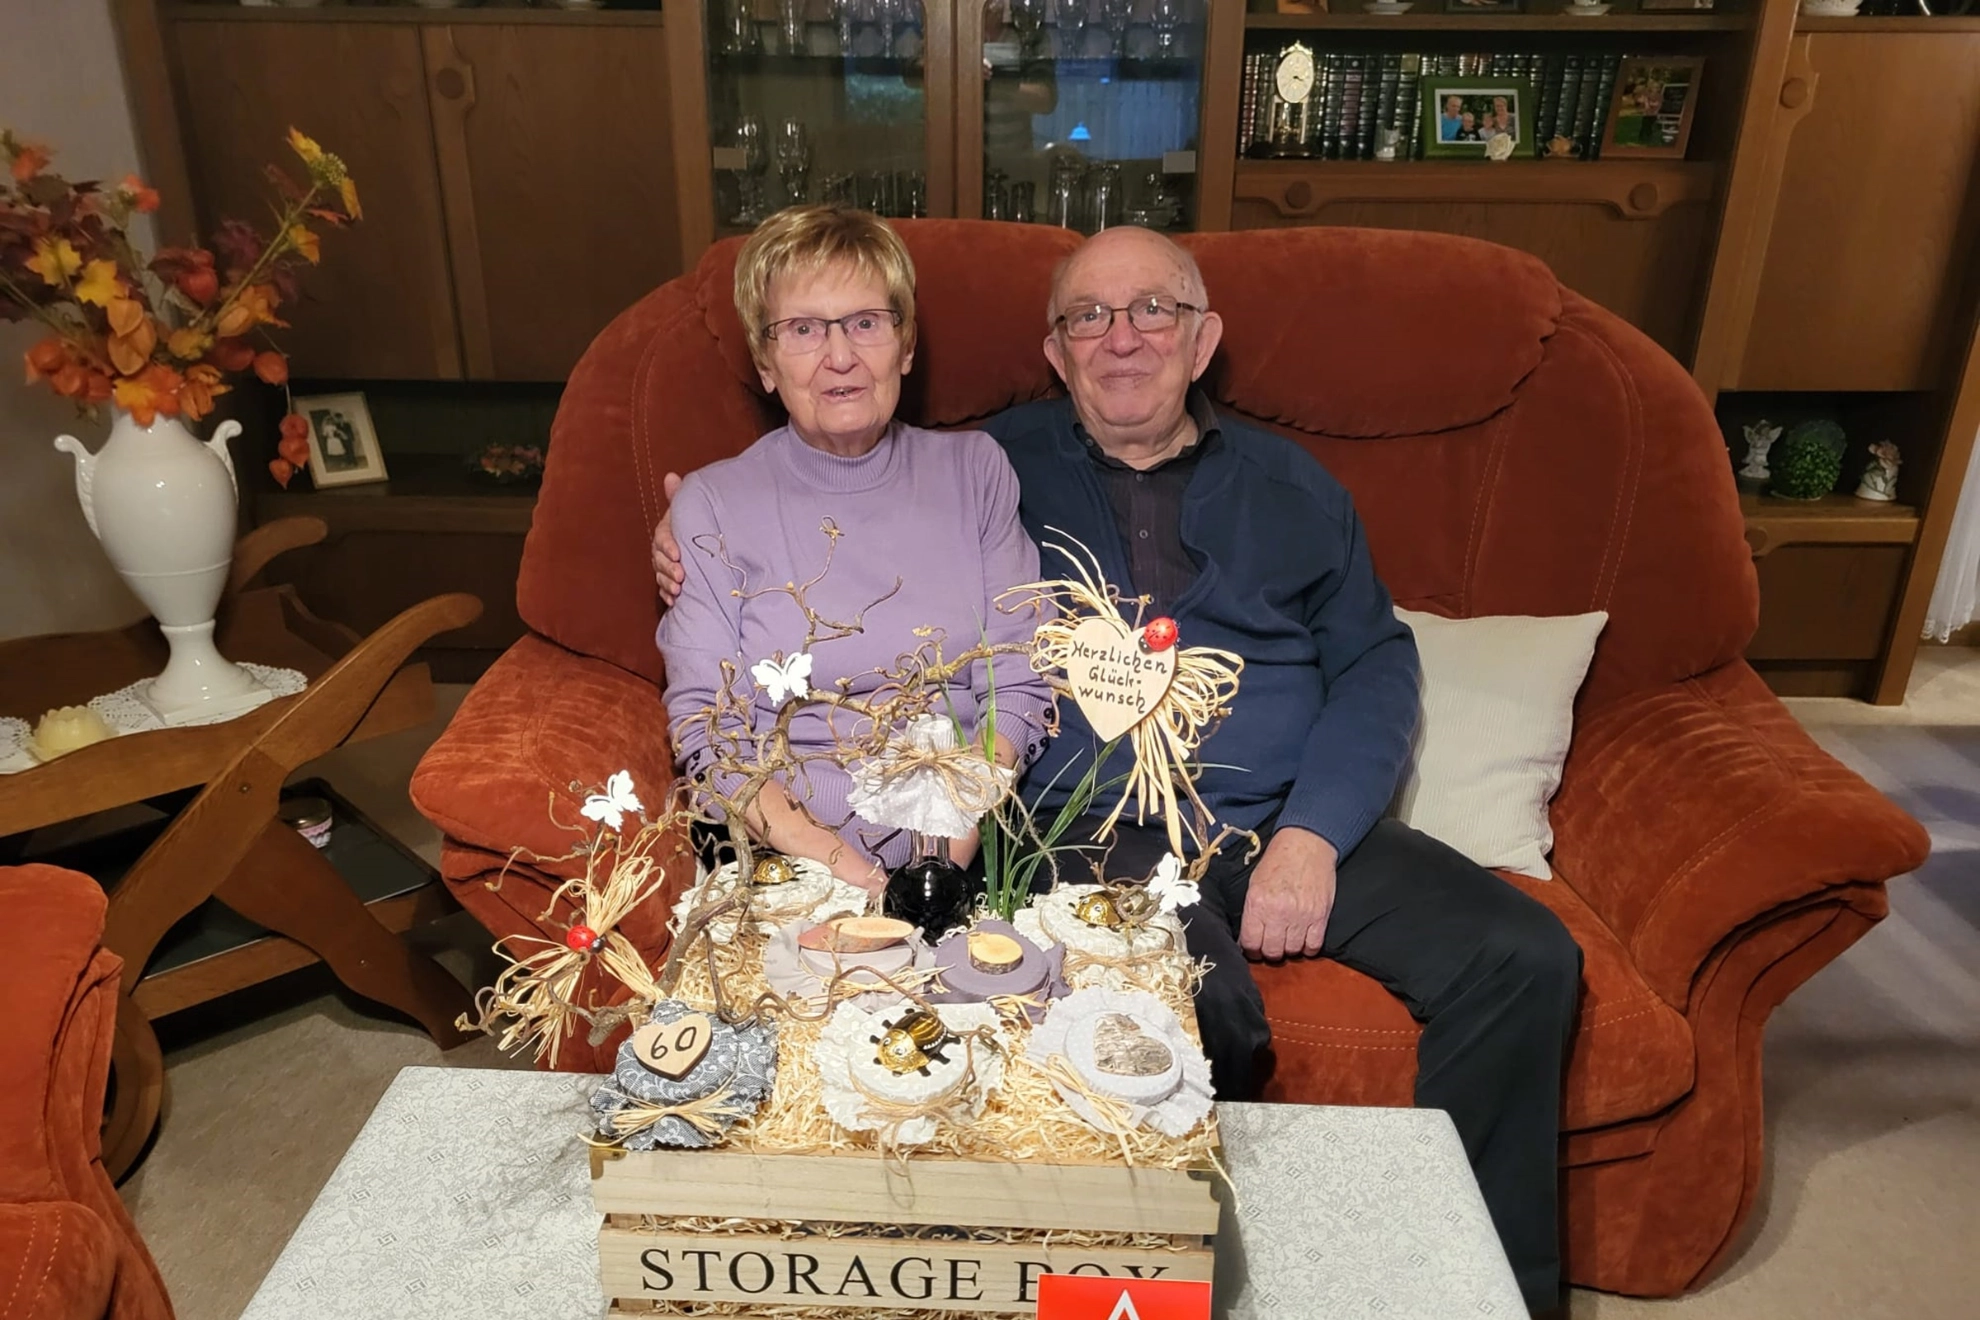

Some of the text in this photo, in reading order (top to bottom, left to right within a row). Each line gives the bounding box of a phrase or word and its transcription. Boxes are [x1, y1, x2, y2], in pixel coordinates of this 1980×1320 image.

[1071, 640, 1167, 674] Herzlichen
[1079, 685, 1146, 715] wunsch
[651, 1026, 697, 1060] 60
[639, 1249, 983, 1301] STORAGE
